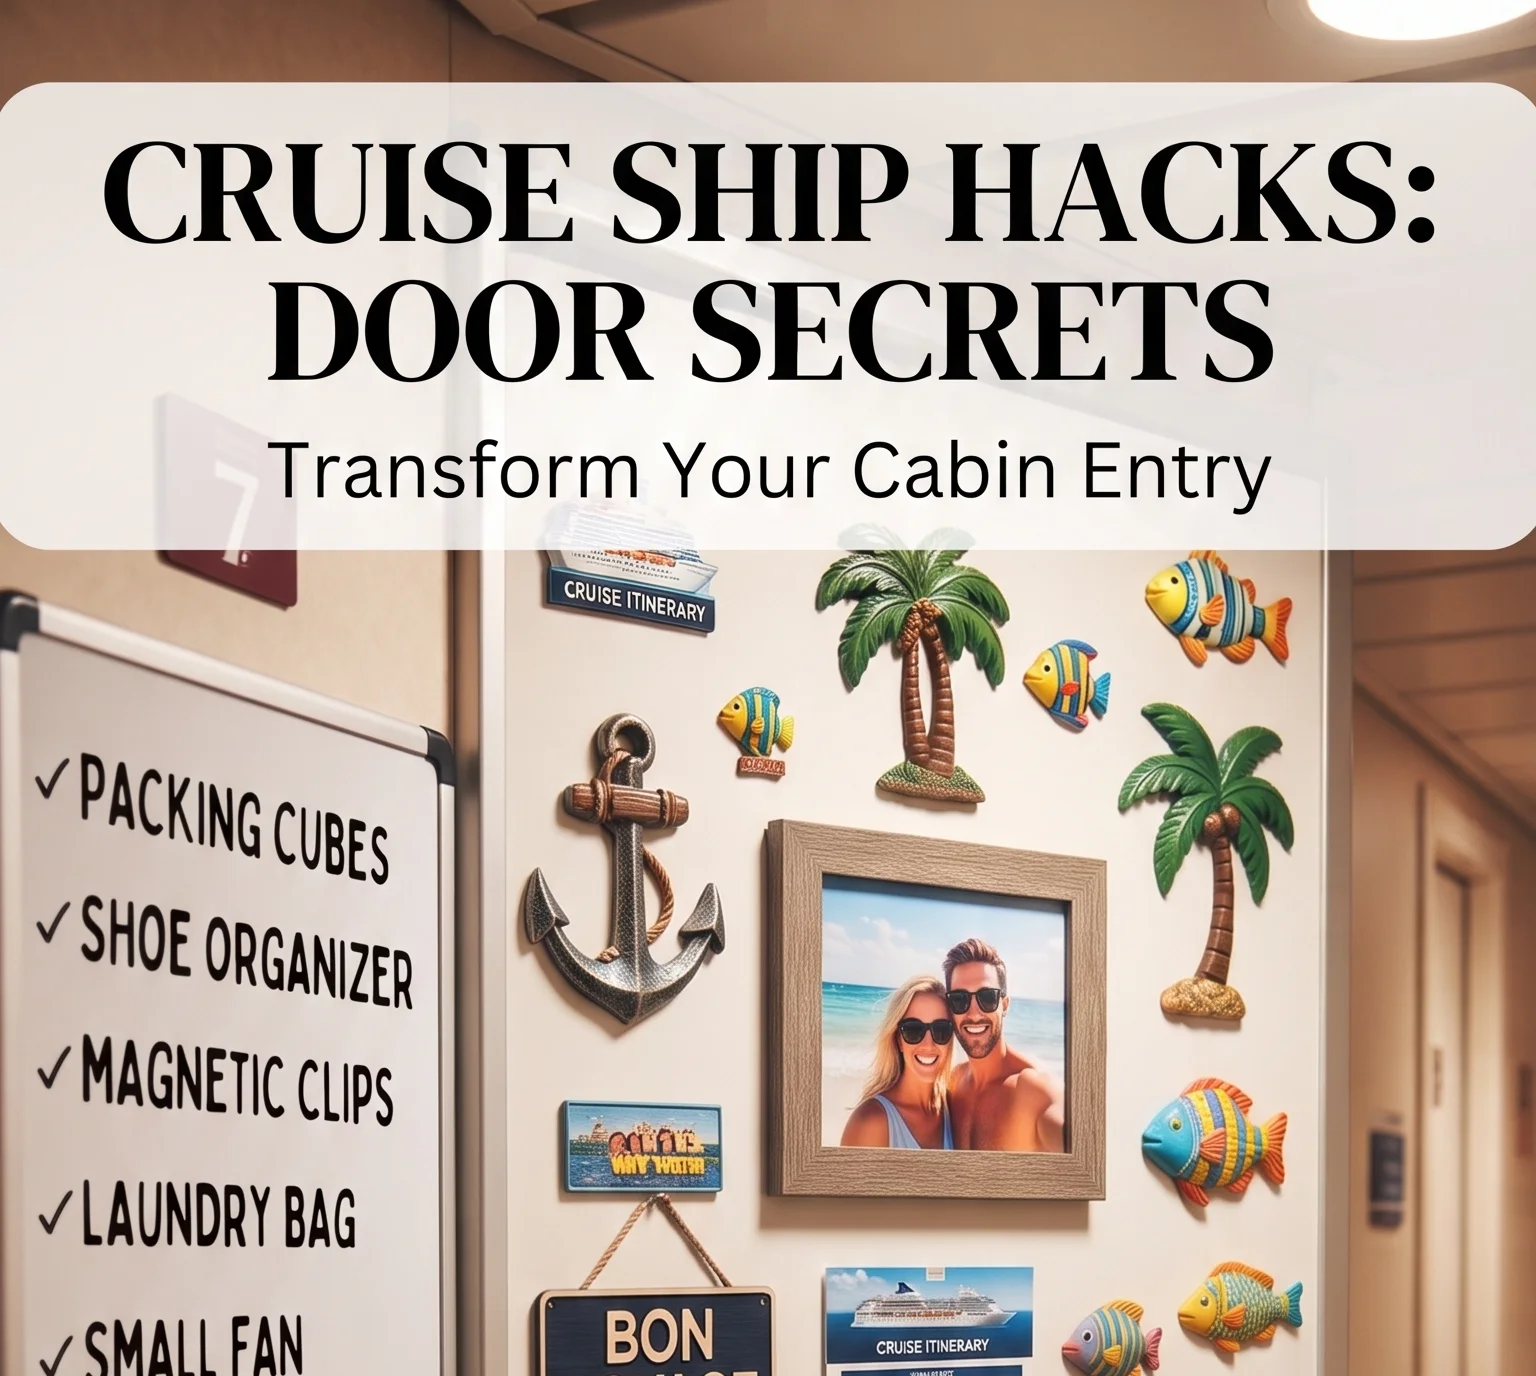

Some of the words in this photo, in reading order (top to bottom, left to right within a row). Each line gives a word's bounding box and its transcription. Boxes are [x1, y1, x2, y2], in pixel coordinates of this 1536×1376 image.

[564, 581, 622, 608] CRUISE
[627, 590, 706, 622] ITINERARY
[80, 752, 261, 859] PACKING
[273, 802, 390, 885] CUBES
[81, 895, 191, 976] SHOE
[205, 916, 413, 1009] ORGANIZER
[82, 1034, 285, 1118] MAGNETIC
[298, 1059, 394, 1127] CLIPS
[82, 1180, 271, 1247] LAUNDRY
[285, 1187, 356, 1248] BAG
[605, 1308, 713, 1364] BON
[876, 1340, 922, 1355] CRUISE
[925, 1339, 990, 1353] ITINERARY
